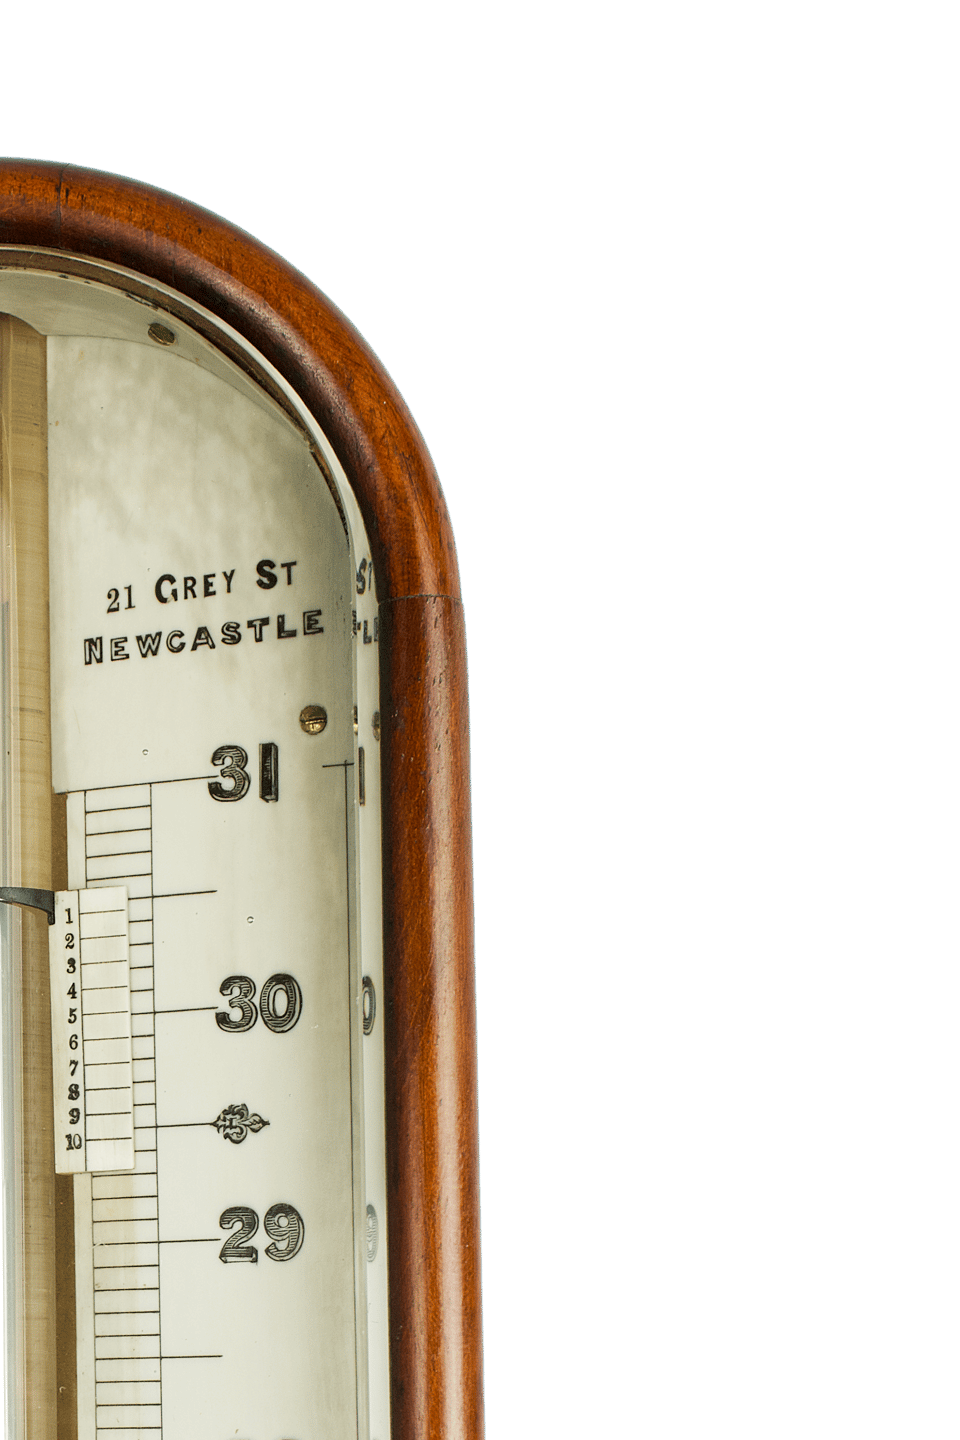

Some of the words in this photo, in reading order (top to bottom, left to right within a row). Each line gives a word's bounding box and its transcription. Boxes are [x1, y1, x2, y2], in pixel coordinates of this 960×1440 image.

[106, 584, 136, 614] 21
[154, 569, 235, 604] GREY
[256, 559, 297, 590] ST
[84, 608, 324, 665] NEWCASTLE
[207, 742, 279, 803] 31
[64, 908, 74, 925] 1
[64, 933, 76, 950] 2
[65, 957, 77, 975] 3
[66, 982, 78, 1000] 4
[215, 972, 303, 1034] 30
[67, 1008, 78, 1025] 5
[68, 1034, 79, 1051] 6
[68, 1060, 80, 1077] 7
[67, 1083, 81, 1102] 8
[67, 1108, 82, 1126] 9
[64, 1134, 83, 1152] 10
[218, 1203, 305, 1264] 29
